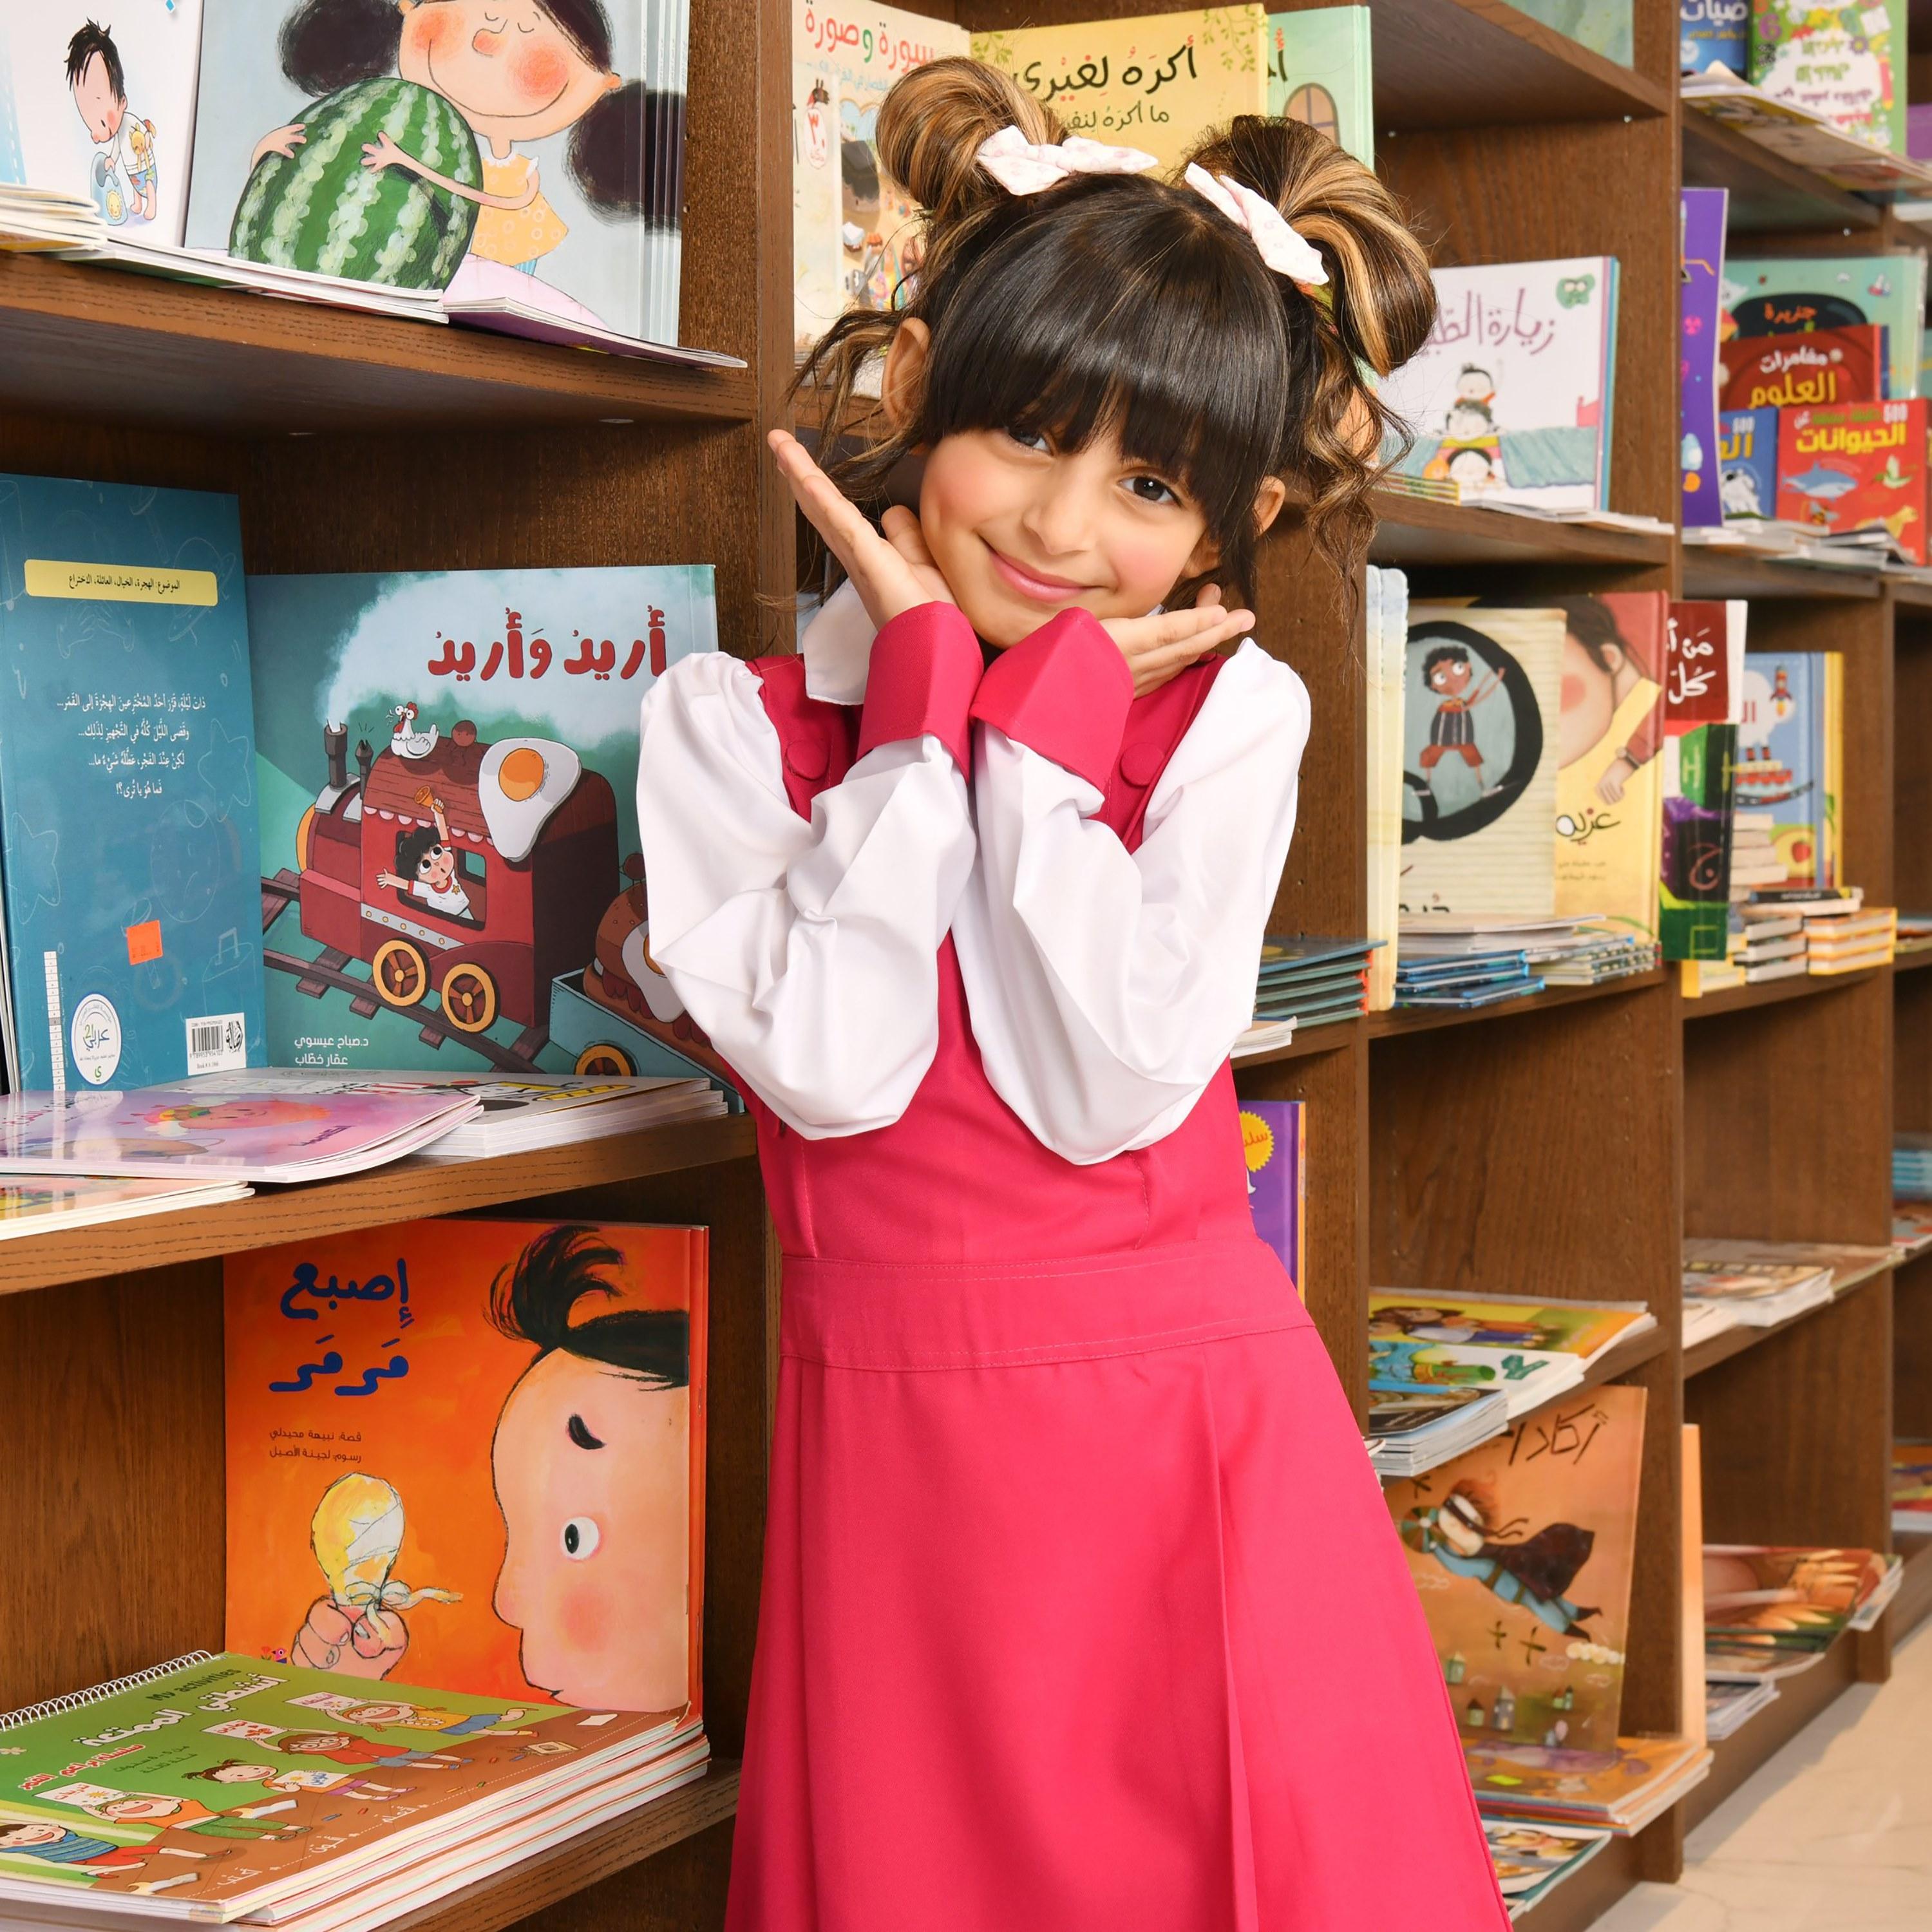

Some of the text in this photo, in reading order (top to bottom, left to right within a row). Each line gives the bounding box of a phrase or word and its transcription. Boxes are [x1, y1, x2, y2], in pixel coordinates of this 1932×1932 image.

[1150, 104, 1170, 122] ما
[1488, 288, 1555, 355] زيارة
[1759, 345, 1828, 374] مغامرات
[1747, 370, 1836, 410] العلوم
[1795, 422, 1907, 454] الحيوانات
[69, 573, 92, 589] الاختراع
[294, 1037, 334, 1049] عيسوي
[269, 1426, 305, 1441] محيدلي
[308, 1429, 334, 1441] نبيهة
[302, 1448, 330, 1461] لجينة
[146, 1669, 242, 1701] My activities
[71, 1708, 195, 1748] الممتعة
[95, 1744, 146, 1762] سلسلة
